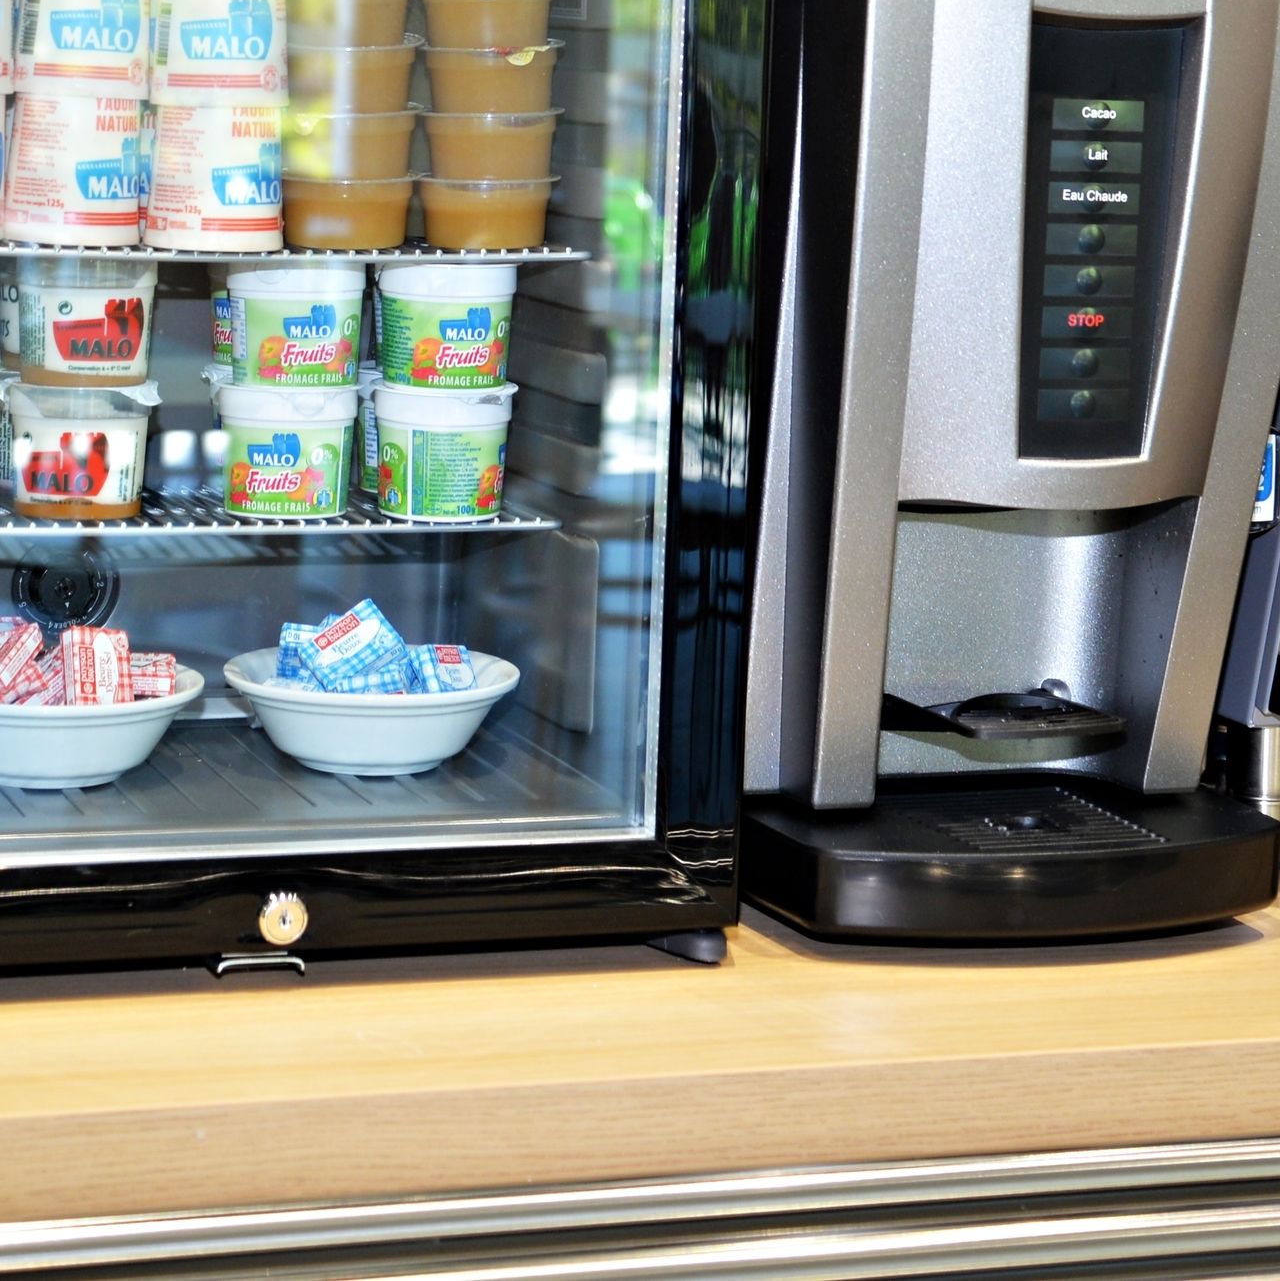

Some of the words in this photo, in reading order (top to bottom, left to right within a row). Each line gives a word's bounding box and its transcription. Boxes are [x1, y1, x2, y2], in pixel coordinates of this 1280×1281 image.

[60, 26, 135, 52] MALO
[191, 35, 265, 60] MALO
[1082, 106, 1117, 119] Cacao
[1088, 148, 1108, 161] Lait
[88, 175, 139, 199] MALO
[224, 179, 281, 205] MALO
[1062, 189, 1085, 201] Eau
[1086, 190, 1128, 203] Chaude
[1067, 313, 1105, 327] STOP
[289, 325, 331, 338] MALO
[445, 327, 486, 341] MALO
[70, 337, 133, 359] MALO
[280, 341, 337, 366] Fruits
[435, 343, 490, 369] Fruits
[275, 373, 319, 385] FROMAGE
[321, 373, 343, 384] FRAIS
[428, 374, 471, 386] FROMAGE
[472, 374, 494, 386] FRAIS
[252, 452, 295, 466] MALO
[383, 444, 399, 462] 0%
[30, 471, 94, 494] MALO
[246, 468, 301, 493] Fruits
[242, 500, 282, 513] FROMAGE
[284, 501, 311, 513] FRAIS
